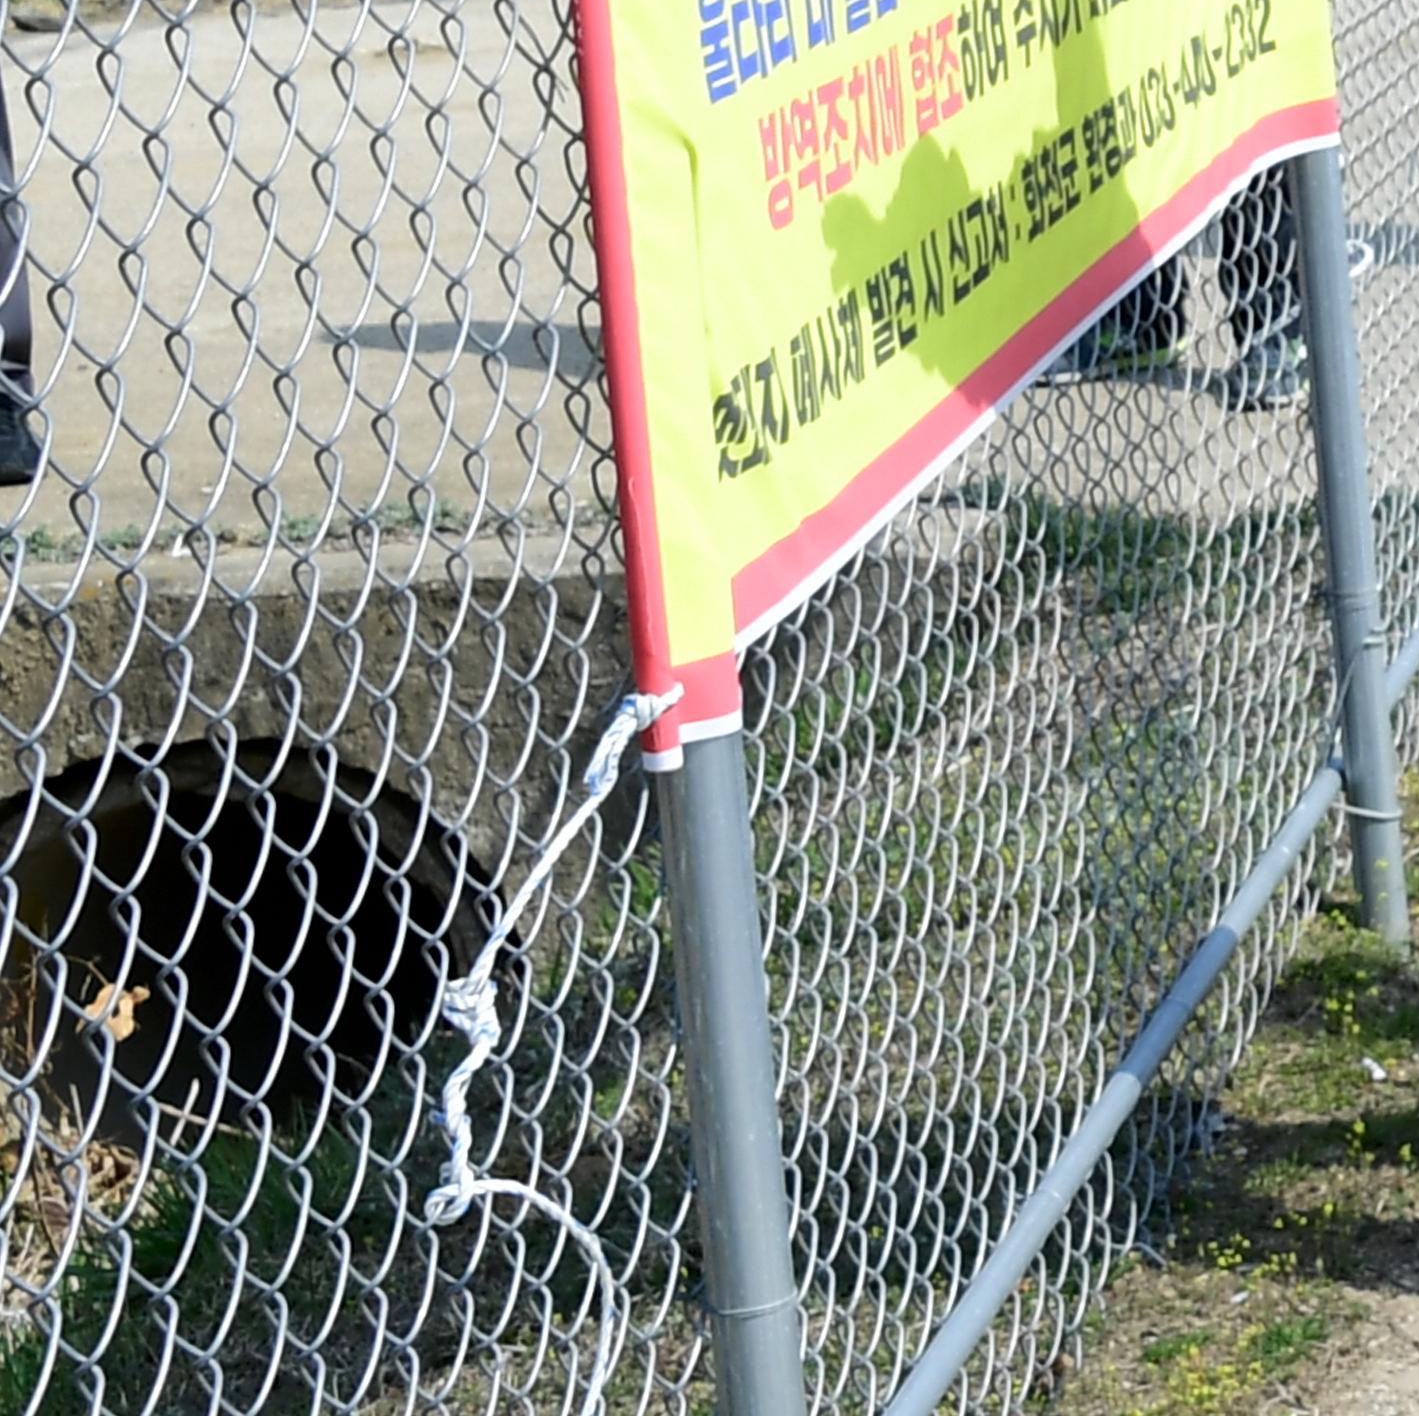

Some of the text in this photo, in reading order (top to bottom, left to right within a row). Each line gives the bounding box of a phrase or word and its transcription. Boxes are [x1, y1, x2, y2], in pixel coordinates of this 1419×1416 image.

[758, 43, 906, 231] 방역조치에
[866, 250, 918, 370] 발견
[921, 230, 945, 324] 시
[1021, 126, 1081, 244] 화천군
